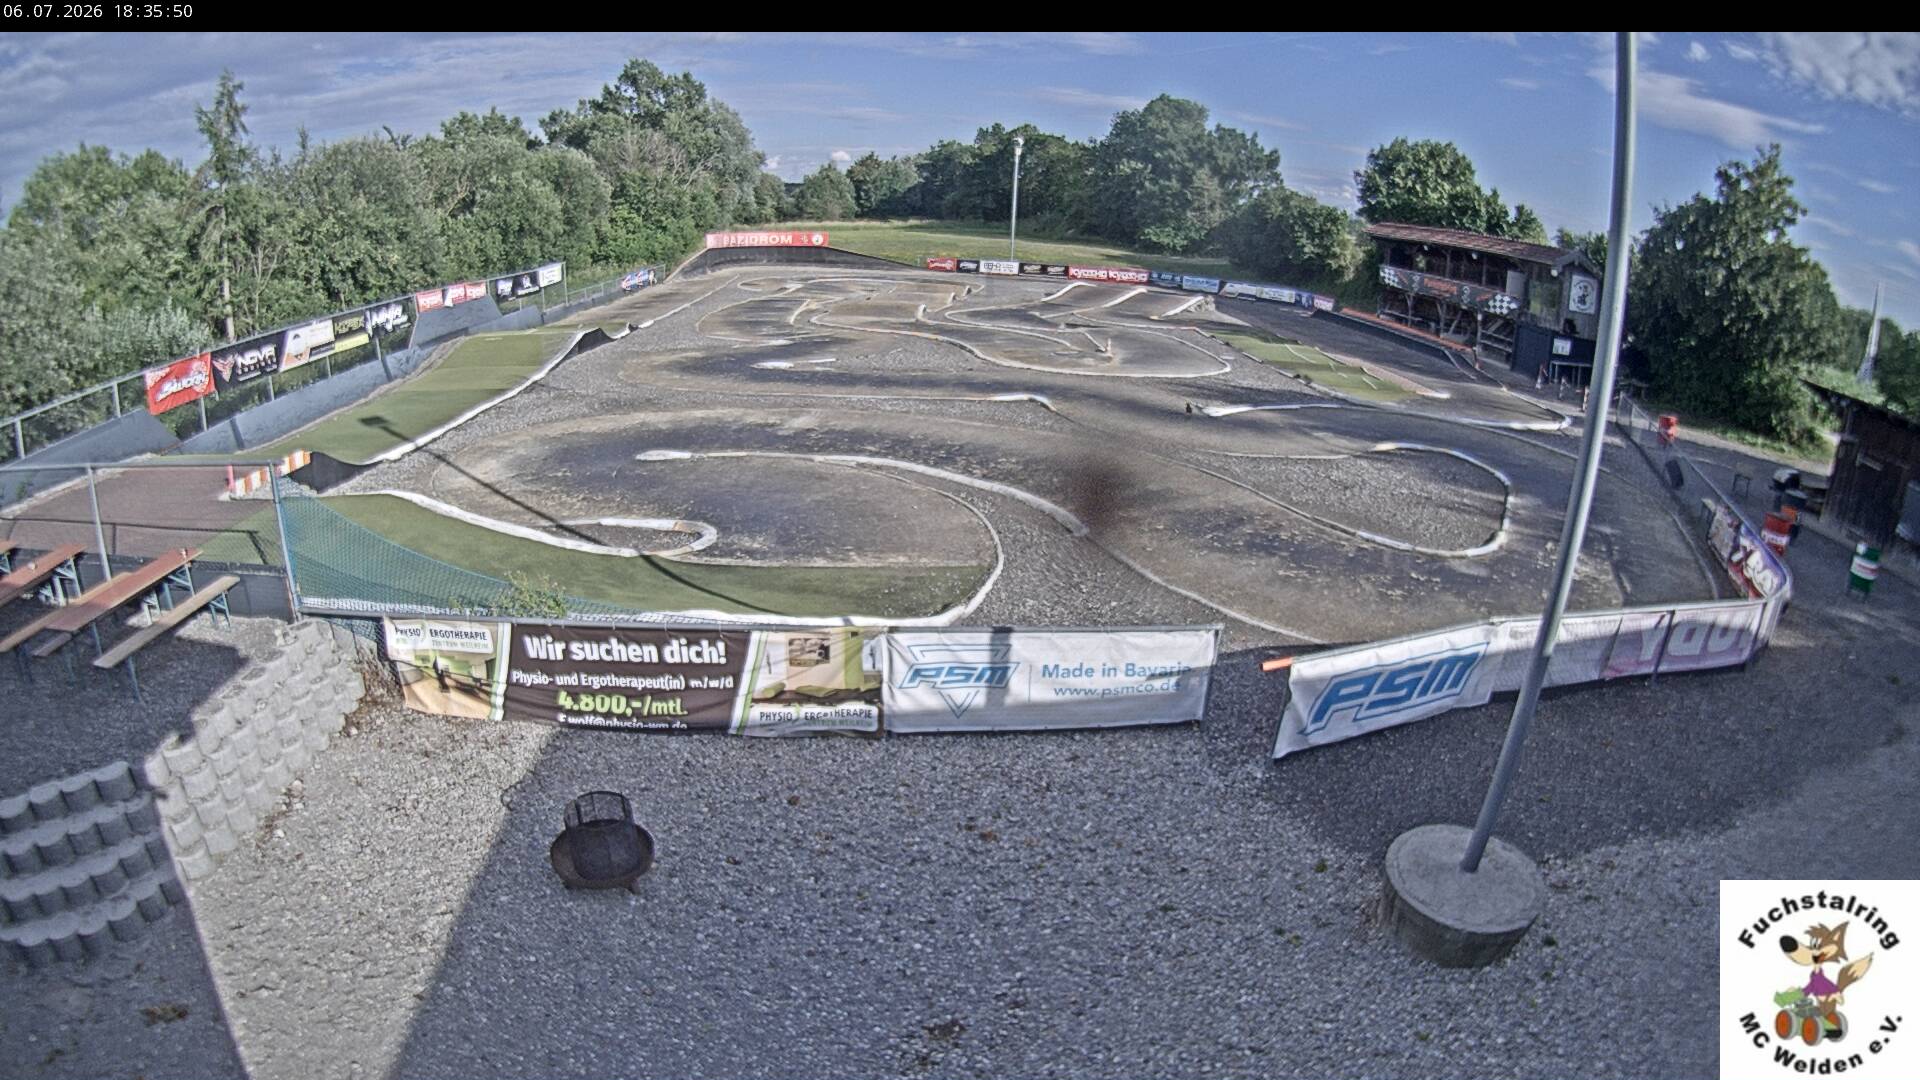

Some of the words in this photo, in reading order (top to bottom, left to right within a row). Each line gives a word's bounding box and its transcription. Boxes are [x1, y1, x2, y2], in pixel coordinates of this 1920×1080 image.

[429, 628, 488, 641] ERGOTHERAPIE
[523, 634, 566, 661] Wir
[570, 636, 659, 664] suchen
[663, 638, 727, 665] dich!
[511, 670, 554, 687] Physio-
[556, 673, 578, 686] und
[580, 675, 686, 691] Ergotherapeut(in)
[689, 675, 734, 689] m/w/d
[904, 662, 1016, 687] PSM
[1041, 662, 1095, 678] Made
[1102, 662, 1117, 678] in
[1305, 647, 1487, 730] PSM
[759, 711, 793, 721] PHYSIO
